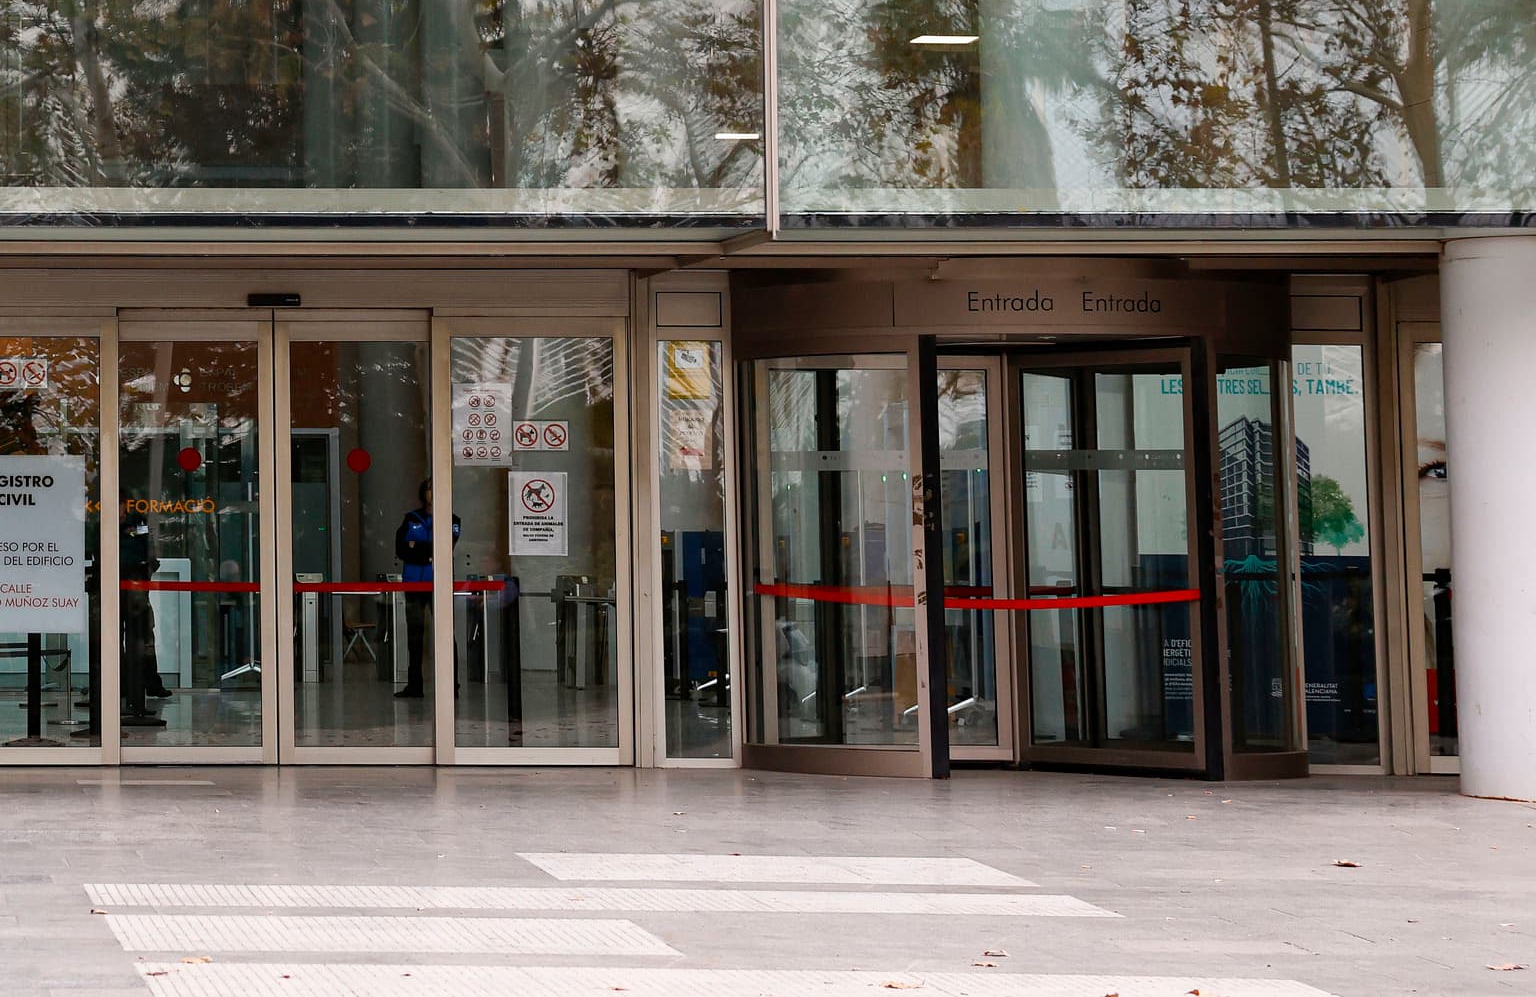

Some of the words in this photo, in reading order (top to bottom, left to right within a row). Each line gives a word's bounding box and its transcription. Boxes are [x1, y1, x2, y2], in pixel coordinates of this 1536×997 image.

[967, 290, 1054, 312] Entrada
[1082, 291, 1161, 313] Entrada
[1217, 379, 1245, 395] TRES
[126, 496, 216, 514] FORMACIÓ
[22, 542, 44, 552] POR
[47, 542, 59, 552] EL
[4, 556, 23, 566] DEL
[26, 556, 74, 566] EDIFICIO
[0, 584, 32, 594] CALLE
[5, 595, 48, 608] MUÑOZ
[52, 597, 80, 608] SUAY
